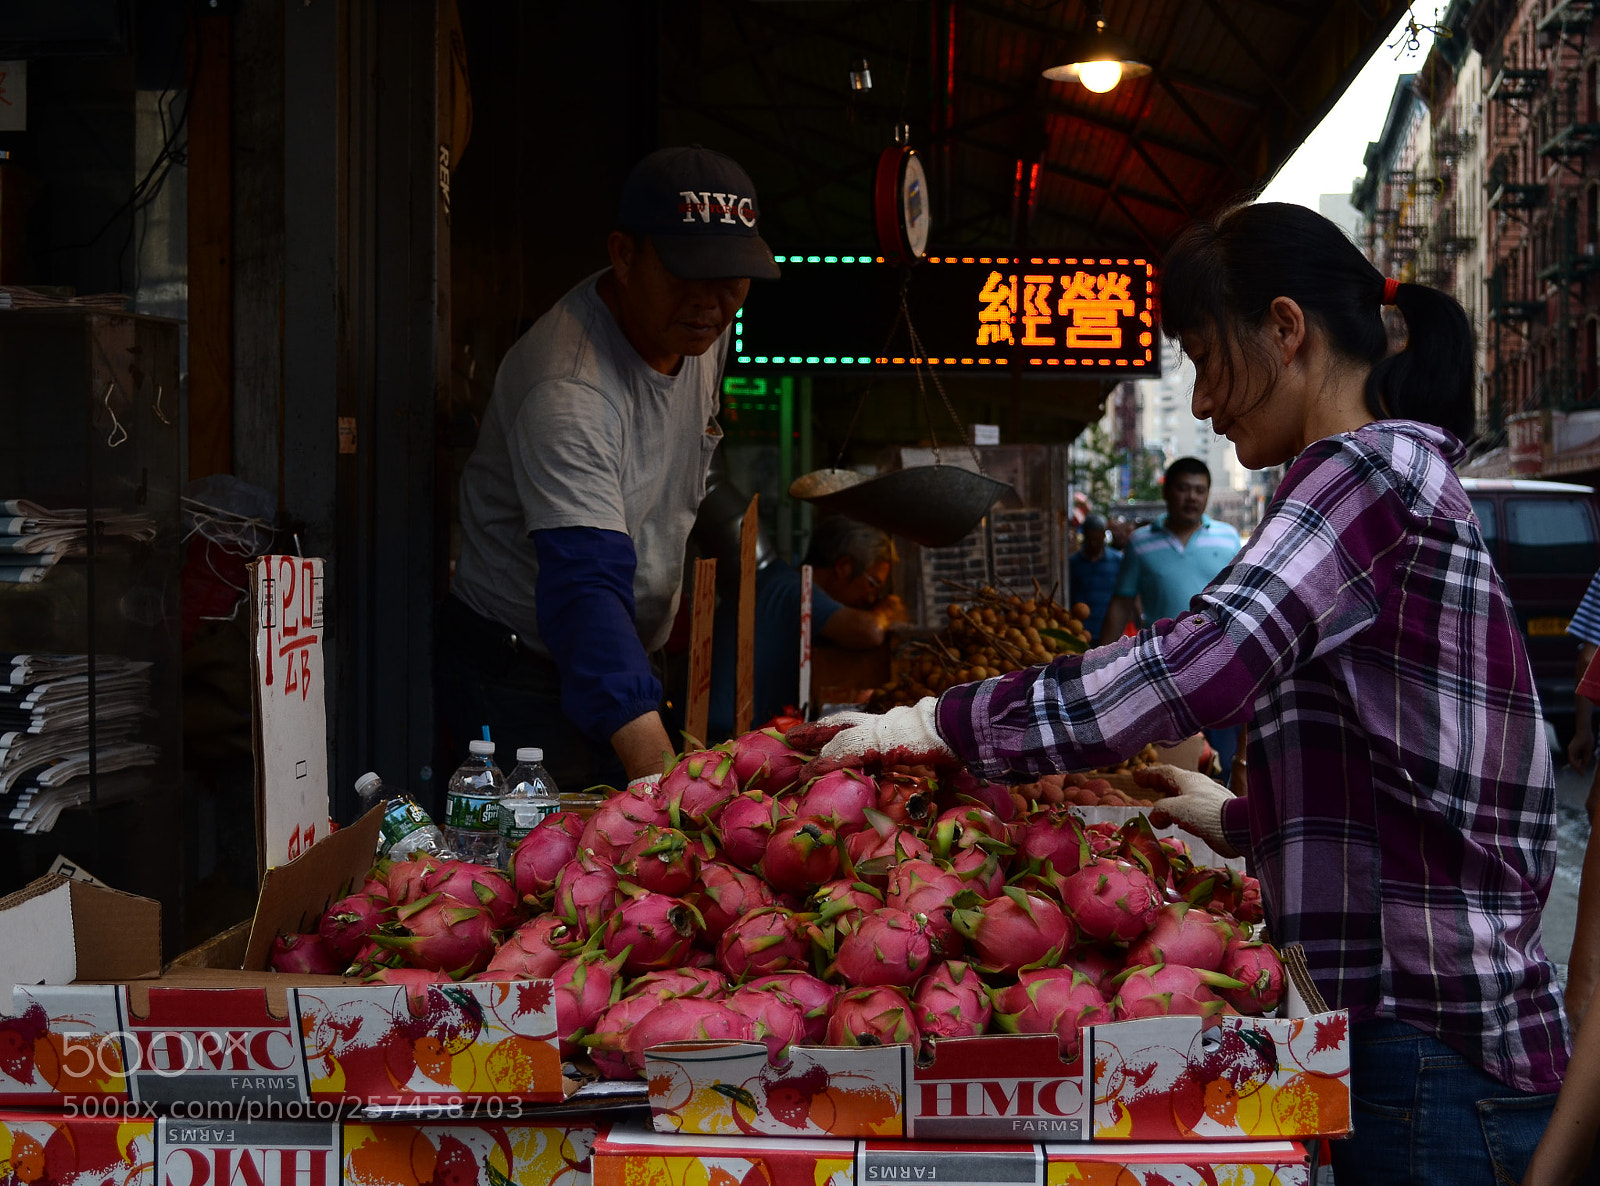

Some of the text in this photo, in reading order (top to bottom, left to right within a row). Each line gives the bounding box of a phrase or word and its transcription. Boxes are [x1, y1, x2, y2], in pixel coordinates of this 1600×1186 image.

[679, 191, 756, 228] NYC
[976, 270, 1135, 349] 經營
[285, 649, 311, 701] LB
[131, 1030, 296, 1071] HMC
[230, 1077, 296, 1090] FARMS
[914, 1079, 1084, 1117] HMC
[169, 1128, 236, 1142] FARMS
[1012, 1120, 1080, 1132] FARMS
[165, 1147, 334, 1186] HMC
[868, 1165, 937, 1180] FARMS
